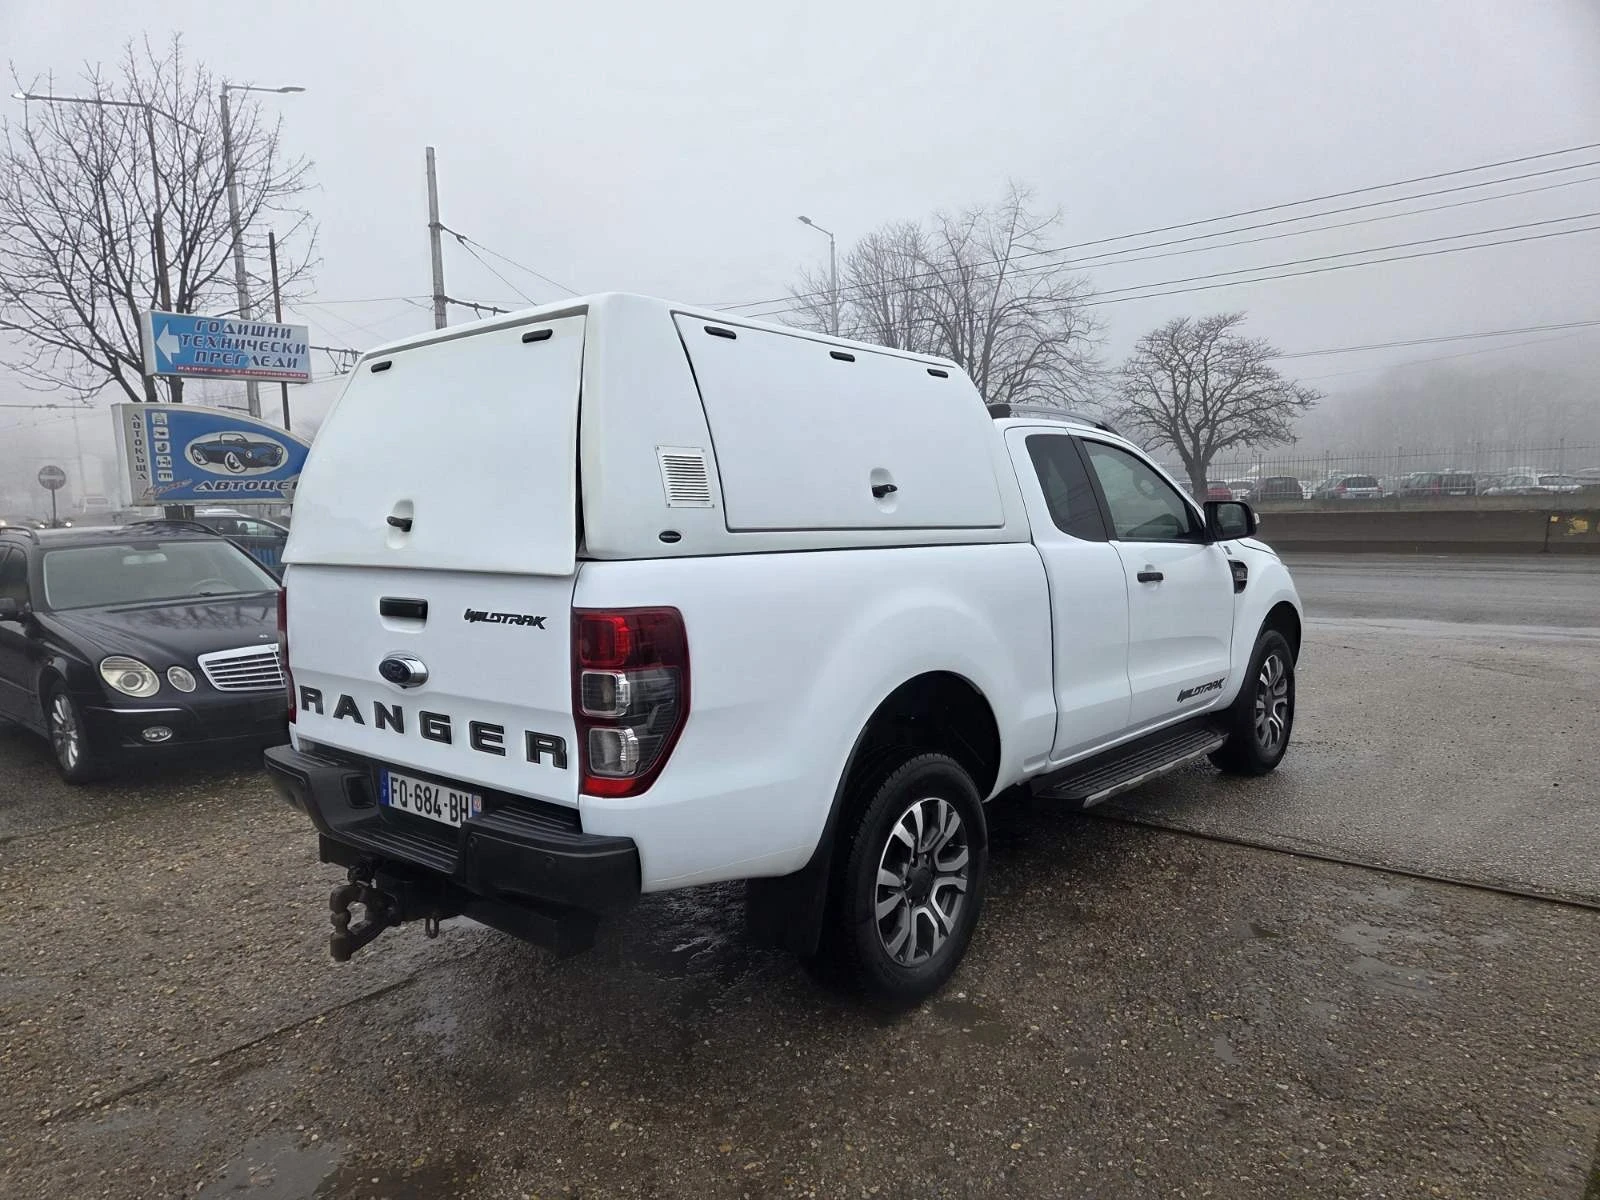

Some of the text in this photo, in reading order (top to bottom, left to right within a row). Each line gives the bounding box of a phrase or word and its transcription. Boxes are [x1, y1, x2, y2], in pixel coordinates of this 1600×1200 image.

[196, 320, 292, 339] ГОДИШНИ
[181, 334, 306, 355] ТЕХНИЧЕСКИ
[194, 351, 298, 369] ПРЕГЛЕДИ
[464, 608, 548, 630] WILDTRAK
[300, 685, 567, 770] RANGER
[390, 776, 469, 823] FQ-684-BH
